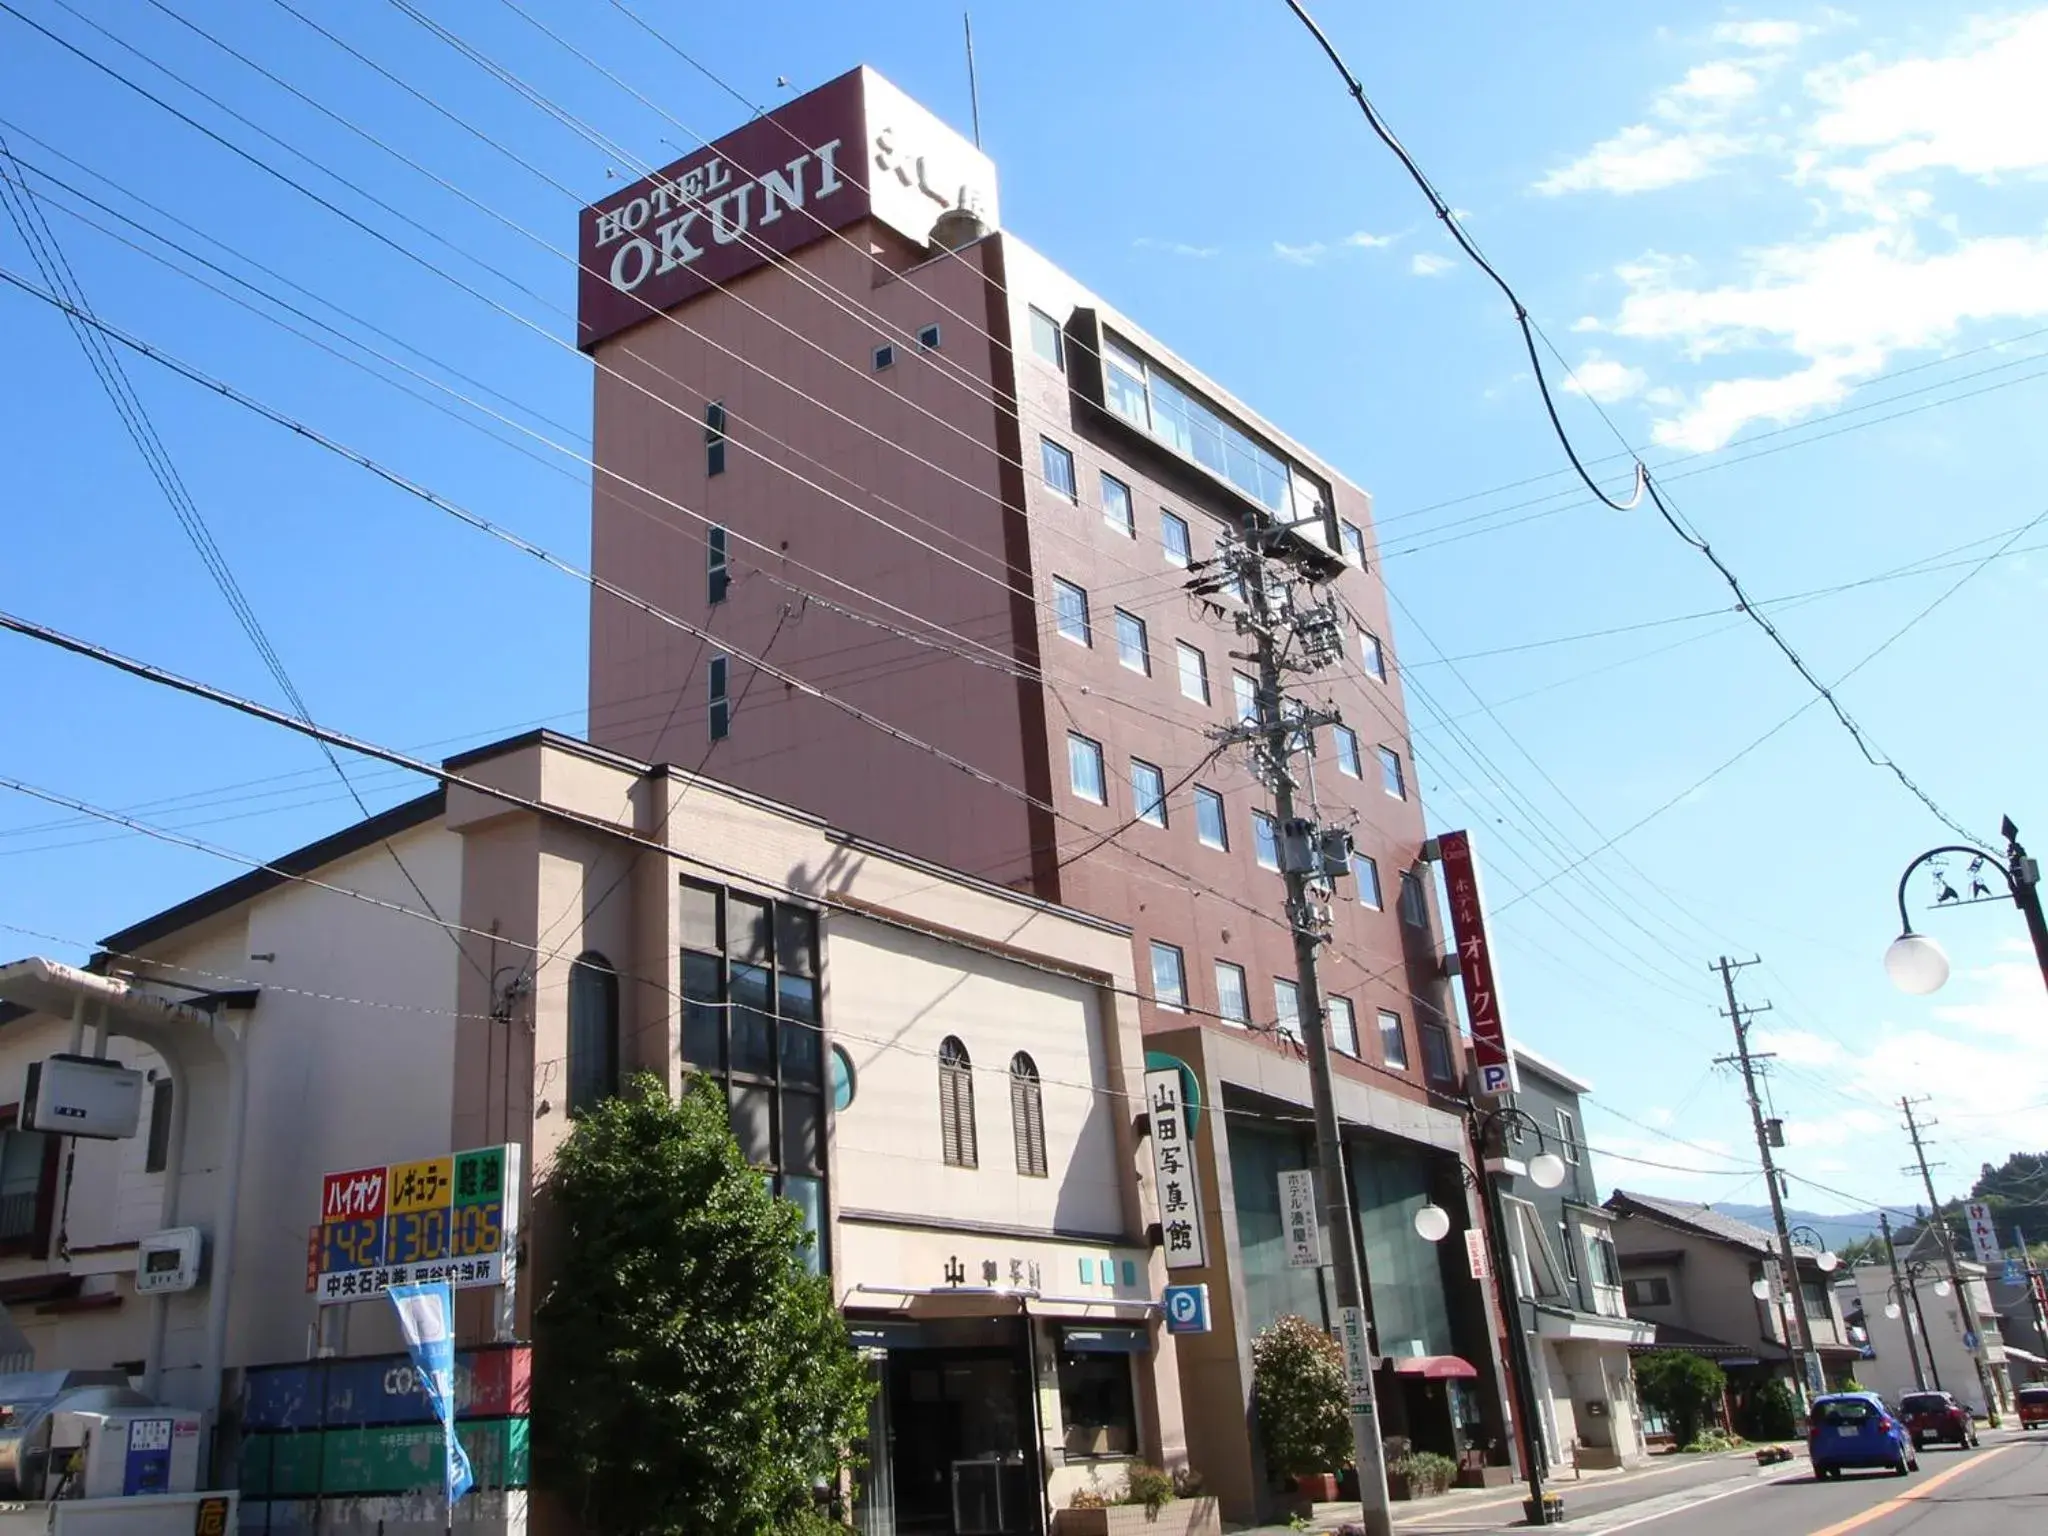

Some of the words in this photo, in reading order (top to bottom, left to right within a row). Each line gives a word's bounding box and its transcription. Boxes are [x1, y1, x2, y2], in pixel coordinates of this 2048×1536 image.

[595, 156, 733, 248] HOTEL
[609, 138, 844, 293] OKUNI
[1454, 877, 1474, 924] ホテル
[1460, 934, 1500, 1041] オークニ
[1483, 1066, 1506, 1091] P
[393, 1164, 449, 1207] レギュラー
[1153, 1083, 1192, 1252] 山田写真館
[327, 1174, 383, 1215] ハイオク
[322, 1219, 376, 1271] 142
[387, 1210, 443, 1262] 130
[453, 1204, 500, 1257] 106
[197, 1499, 225, 1536] 危
